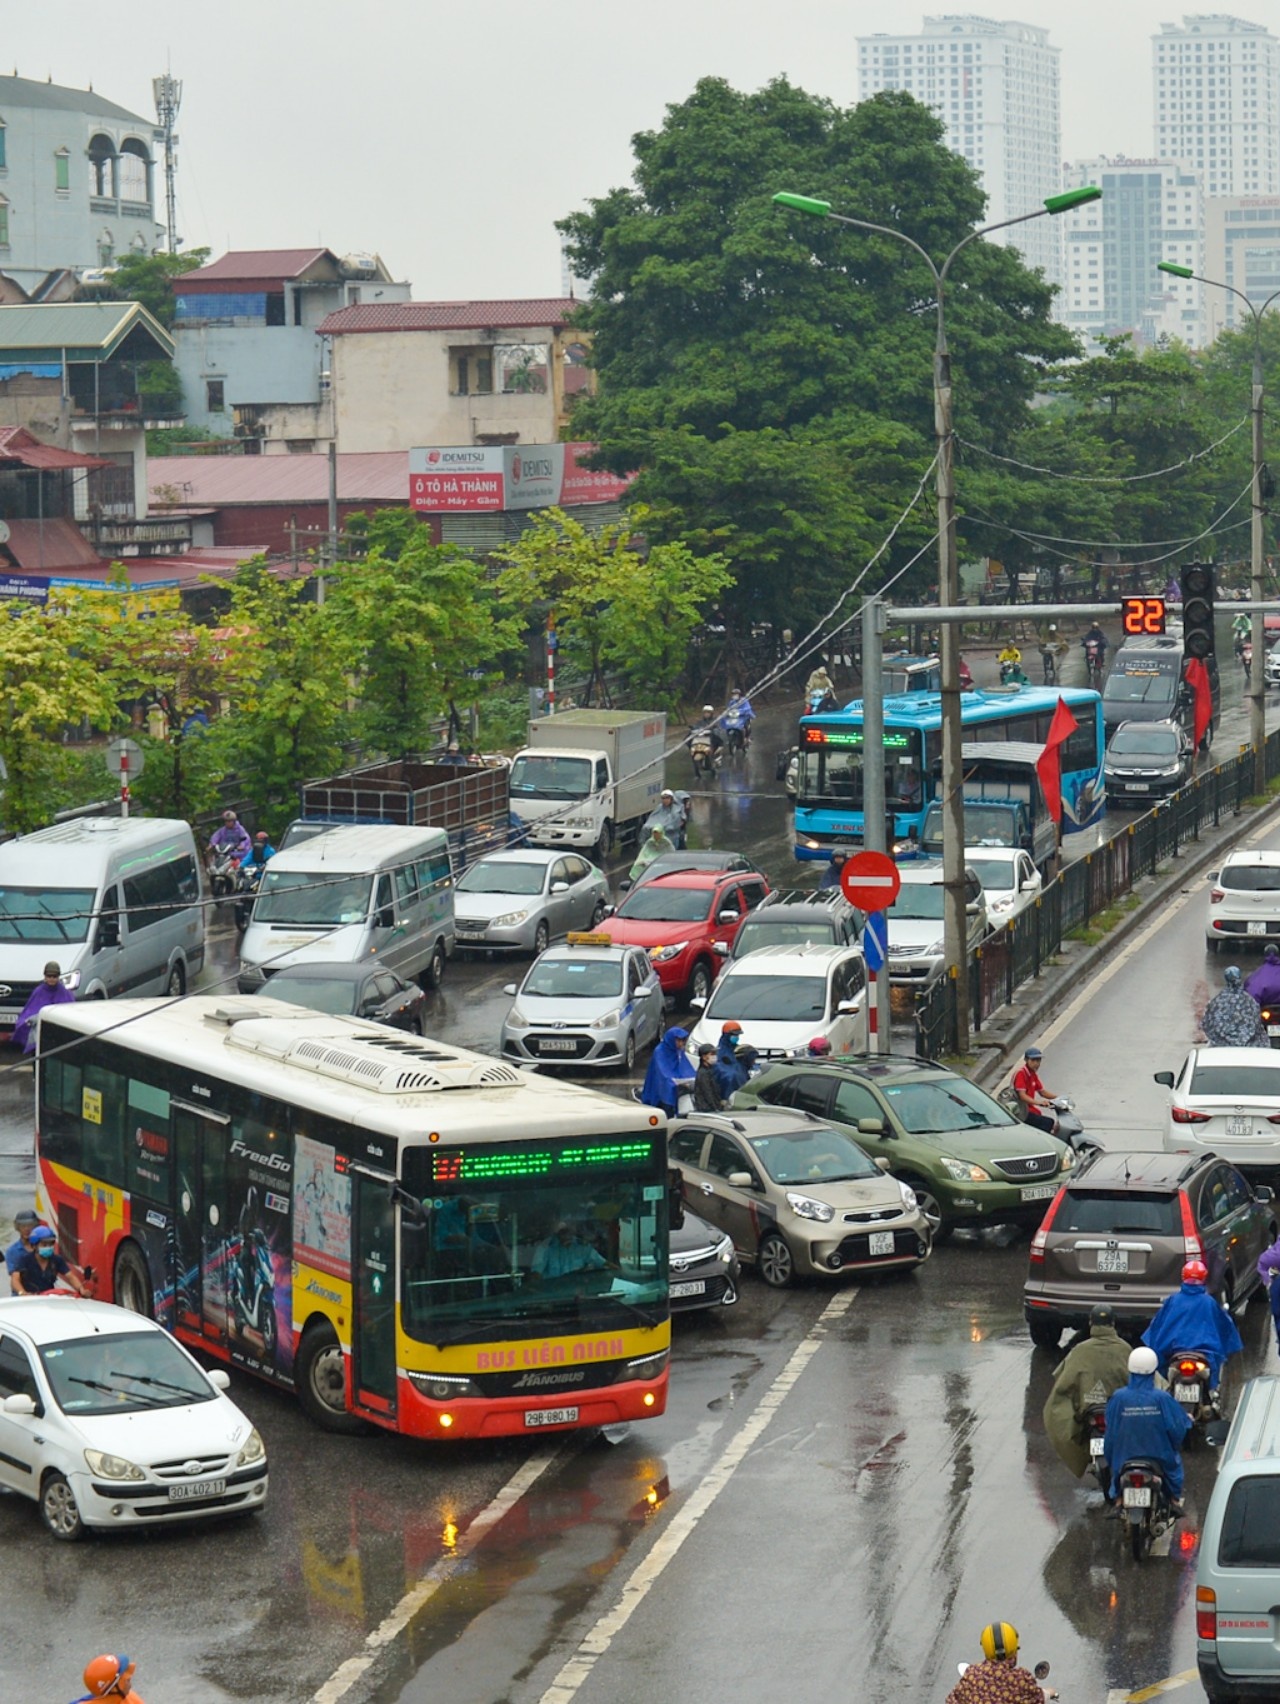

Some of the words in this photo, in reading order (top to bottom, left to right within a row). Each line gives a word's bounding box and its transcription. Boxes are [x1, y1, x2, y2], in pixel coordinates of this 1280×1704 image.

[442, 452, 485, 464] IDEMITSU
[522, 459, 552, 478] IDEMITSU
[416, 479, 424, 493] Ô
[426, 478, 441, 493] TÔ
[444, 478, 458, 493] HÀ
[461, 477, 497, 492] THÀNH
[447, 497, 467, 507] Máy
[1126, 600, 1164, 632] 22
[1116, 662, 1172, 670] LIMOUSINE
[230, 1140, 292, 1172] FreeGo
[1104, 1250, 1121, 1261] 29A
[1098, 1261, 1128, 1272] 637.89
[477, 1351, 516, 1369] BUS
[523, 1343, 565, 1366] LIÊN
